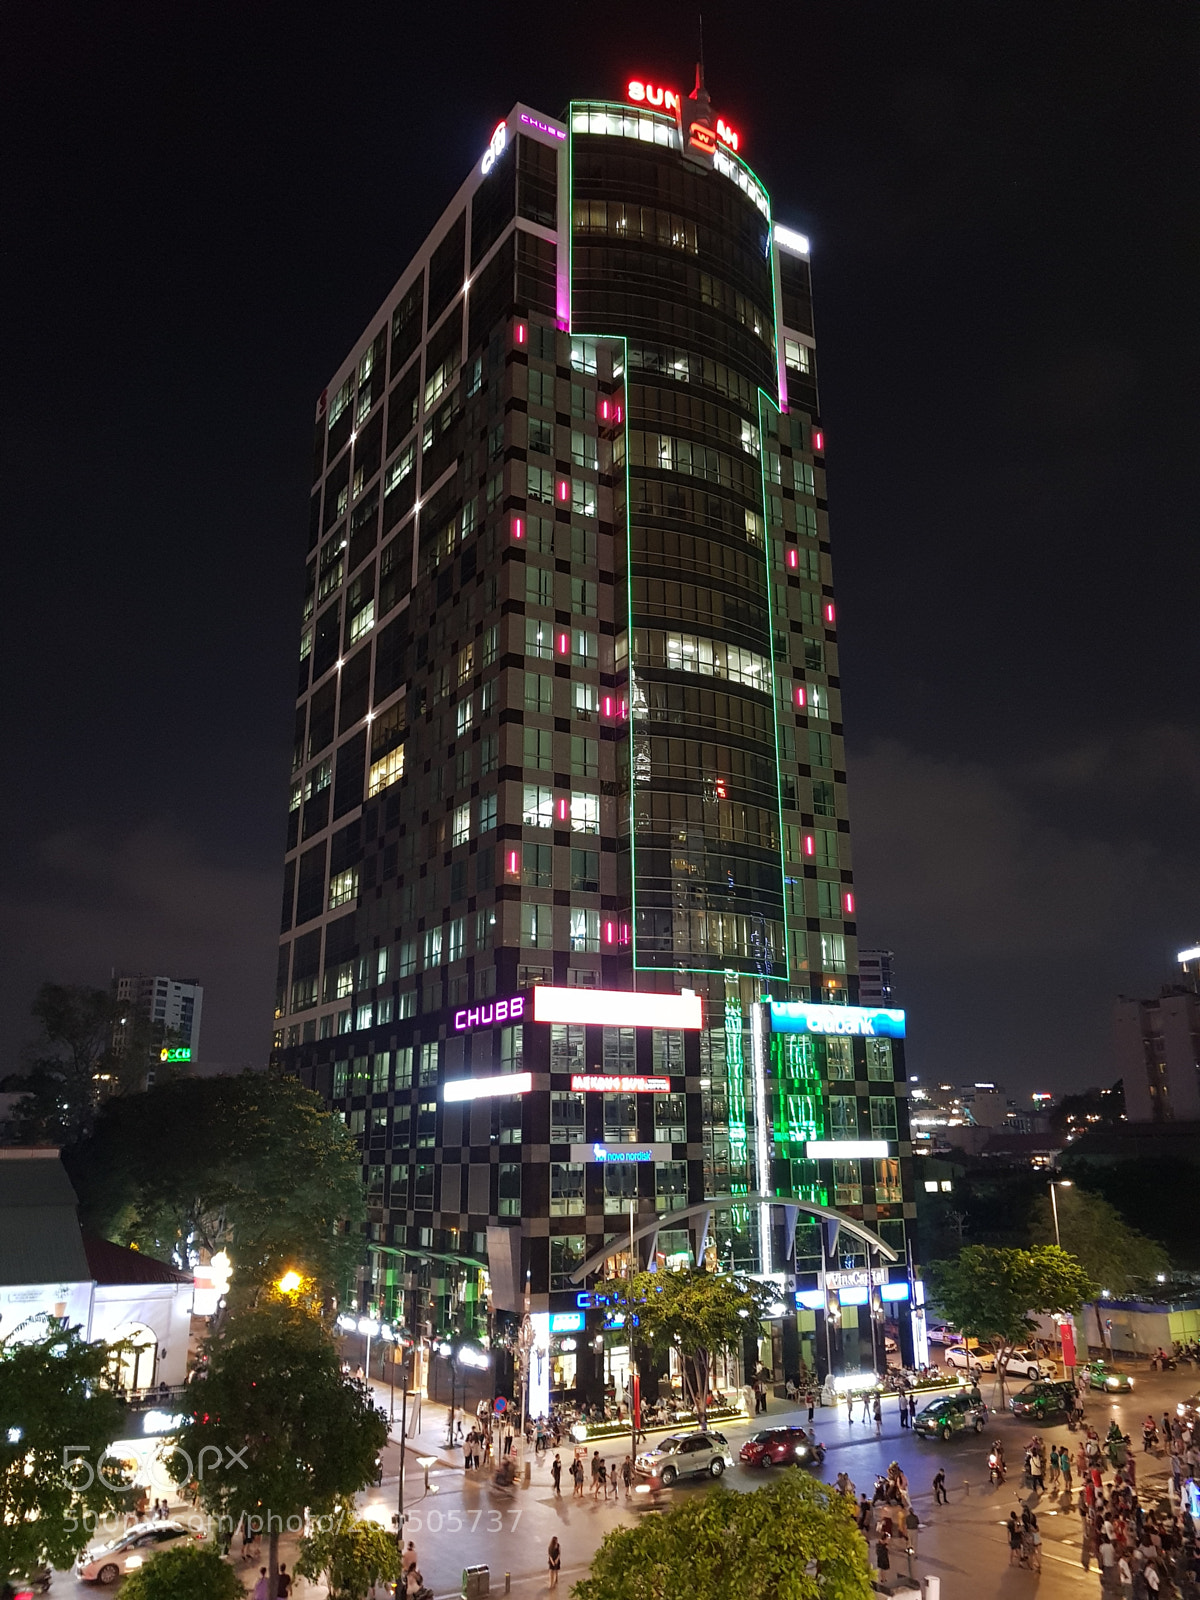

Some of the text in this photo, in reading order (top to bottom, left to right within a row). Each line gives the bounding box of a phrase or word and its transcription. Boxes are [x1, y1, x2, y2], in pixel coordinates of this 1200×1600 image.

[628, 81, 680, 109] SUN
[455, 997, 523, 1029] CHUBB
[607, 1151, 651, 1161] novo nordisk
[833, 1268, 886, 1287] VinaCaptal
